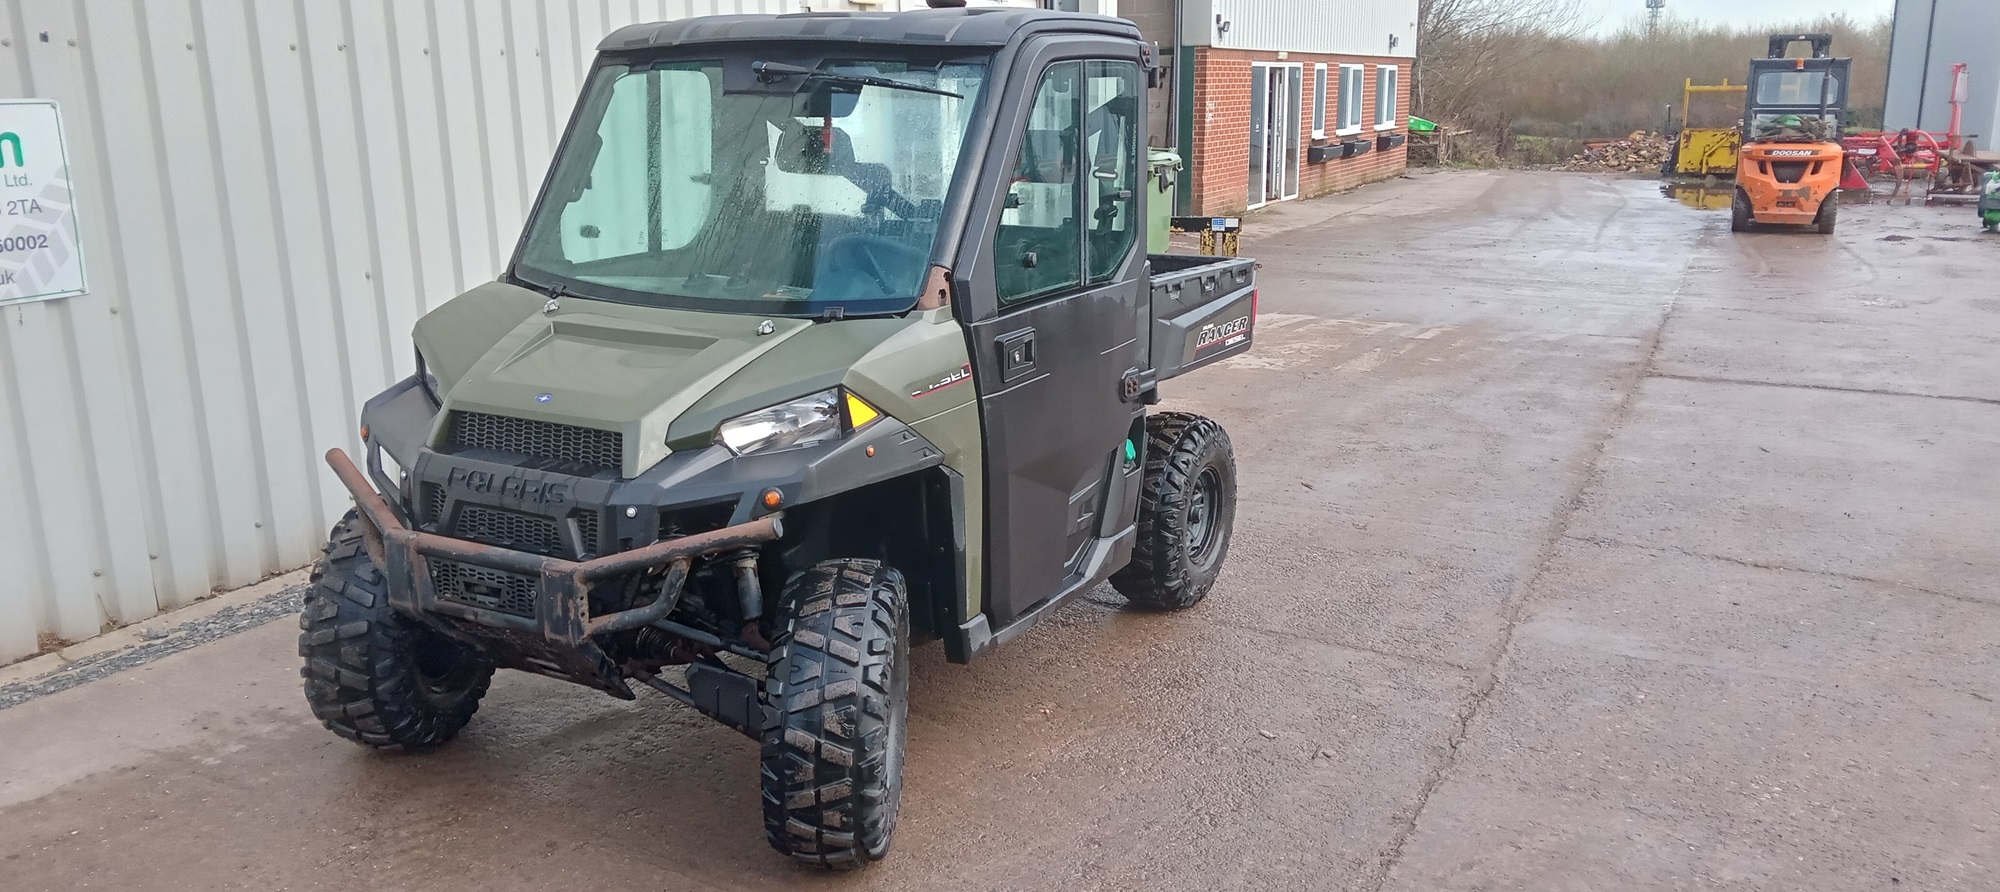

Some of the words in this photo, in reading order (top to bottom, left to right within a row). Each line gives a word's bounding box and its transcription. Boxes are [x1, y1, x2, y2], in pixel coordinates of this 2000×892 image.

[4, 173, 33, 188] Ltd.
[7, 198, 42, 215] 2TA
[1196, 315, 1248, 348] RANGER
[447, 466, 569, 506] POLARIS
